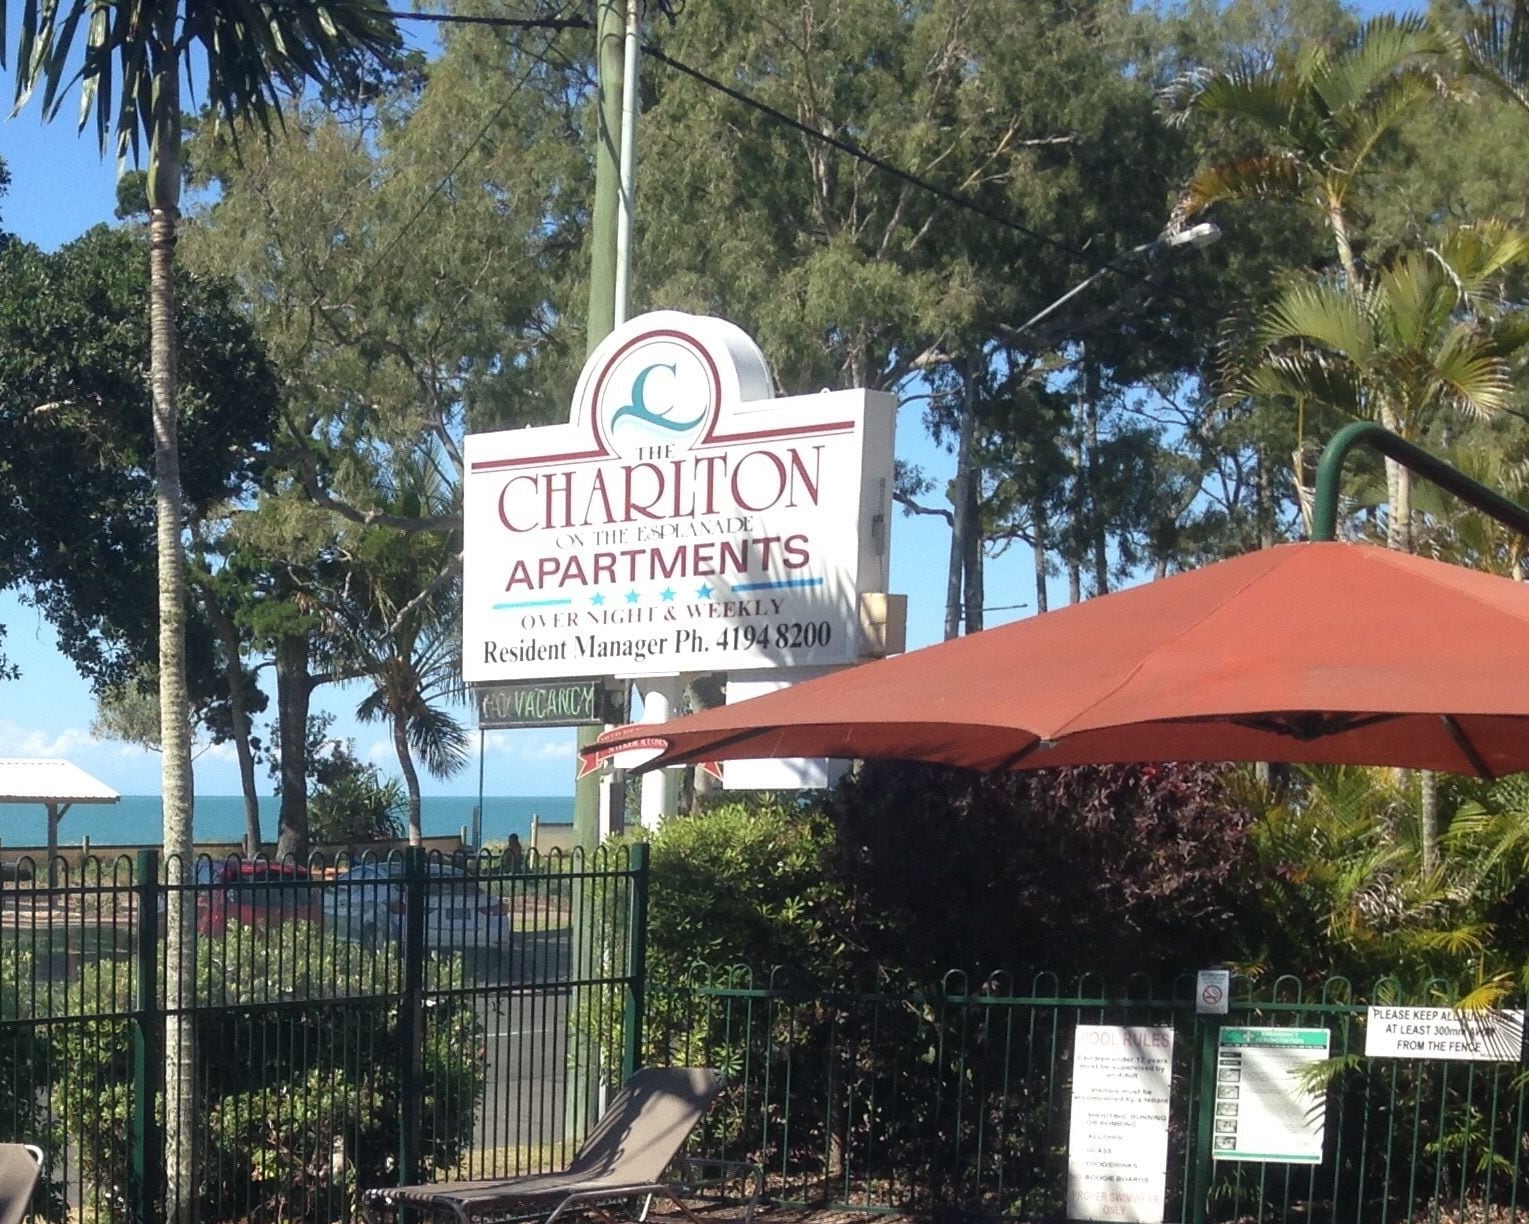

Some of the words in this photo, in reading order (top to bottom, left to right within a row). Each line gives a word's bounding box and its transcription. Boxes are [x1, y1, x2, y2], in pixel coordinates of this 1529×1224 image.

[635, 443, 676, 461] THE
[498, 446, 826, 533] CHARLTON
[556, 534, 584, 549] ON
[593, 528, 629, 546] THE
[637, 515, 754, 542] ESPLANADE
[505, 534, 810, 592] APARTMENTS
[664, 605, 677, 621] &
[687, 598, 785, 619] WEEKLY
[484, 638, 567, 664] Resident
[574, 633, 668, 663] Manager
[675, 628, 710, 654] Ph.
[716, 623, 770, 652] 4194
[775, 620, 832, 649] 8200
[515, 685, 594, 718] VACANCY
[1373, 1009, 1410, 1020] PLEASE
[1413, 1010, 1438, 1021] KEEP
[1441, 1012, 1459, 1022] ALL
[1123, 1031, 1170, 1048] RULES
[1386, 1024, 1398, 1034] AT
[1401, 1025, 1431, 1035] LEAST
[1397, 1040, 1425, 1050] FROM
[1428, 1041, 1446, 1051] THE
[1449, 1042, 1481, 1053] FENCE
